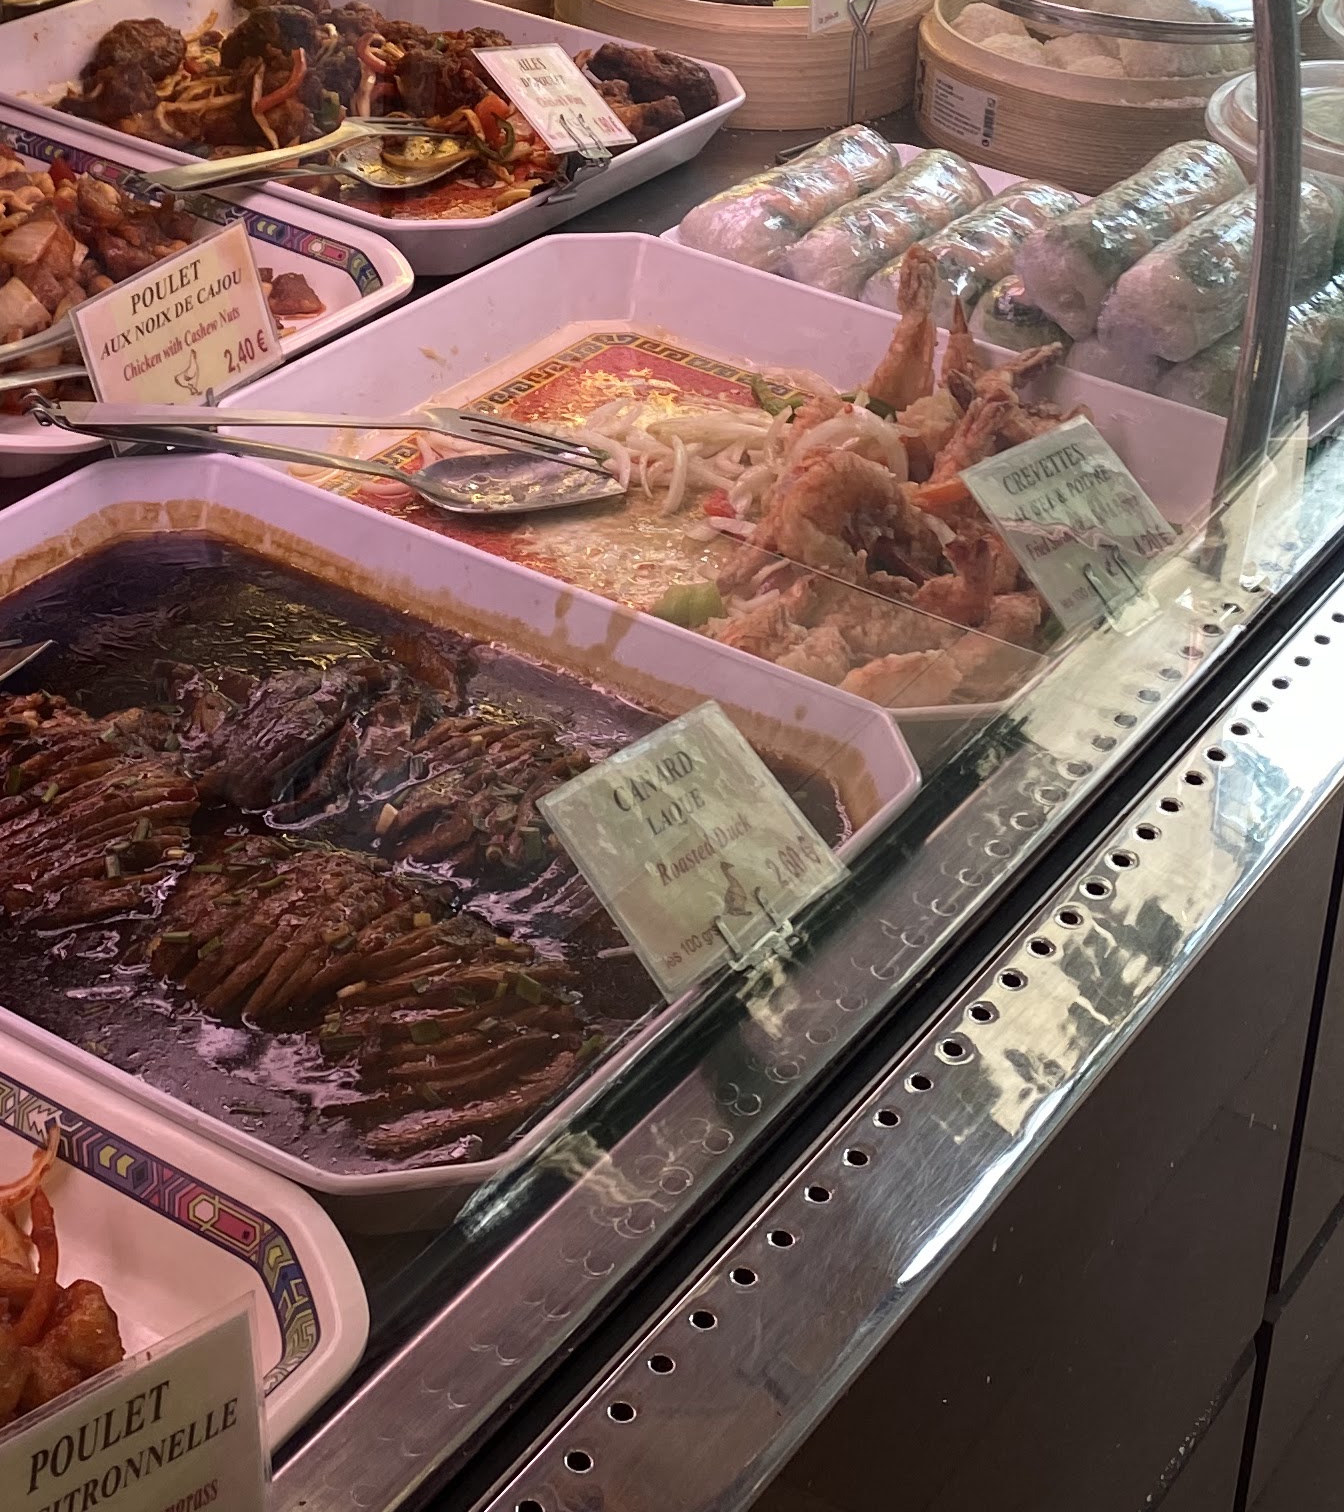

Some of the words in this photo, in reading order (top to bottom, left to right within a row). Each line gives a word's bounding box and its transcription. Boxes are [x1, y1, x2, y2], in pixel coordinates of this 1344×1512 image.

[518, 57, 547, 72] AILES
[100, 328, 133, 361] AUX
[134, 308, 172, 342] NOIX
[174, 294, 195, 320] DE
[196, 267, 242, 305] CAJOU
[130, 259, 202, 316] POULET
[123, 351, 162, 382] Chicken
[162, 336, 184, 363] with
[184, 317, 218, 348] Cashew
[218, 306, 241, 329] Nuts
[223, 336, 256, 374] 2,40
[256, 329, 269, 353] €
[1002, 443, 1087, 496] CREVETTES
[613, 750, 694, 812] CANARD
[646, 787, 706, 836] LAQUE
[656, 836, 716, 888] Roasted
[714, 811, 754, 848] Duck
[680, 936, 704, 956] 100
[26, 1379, 170, 1496] POULET
